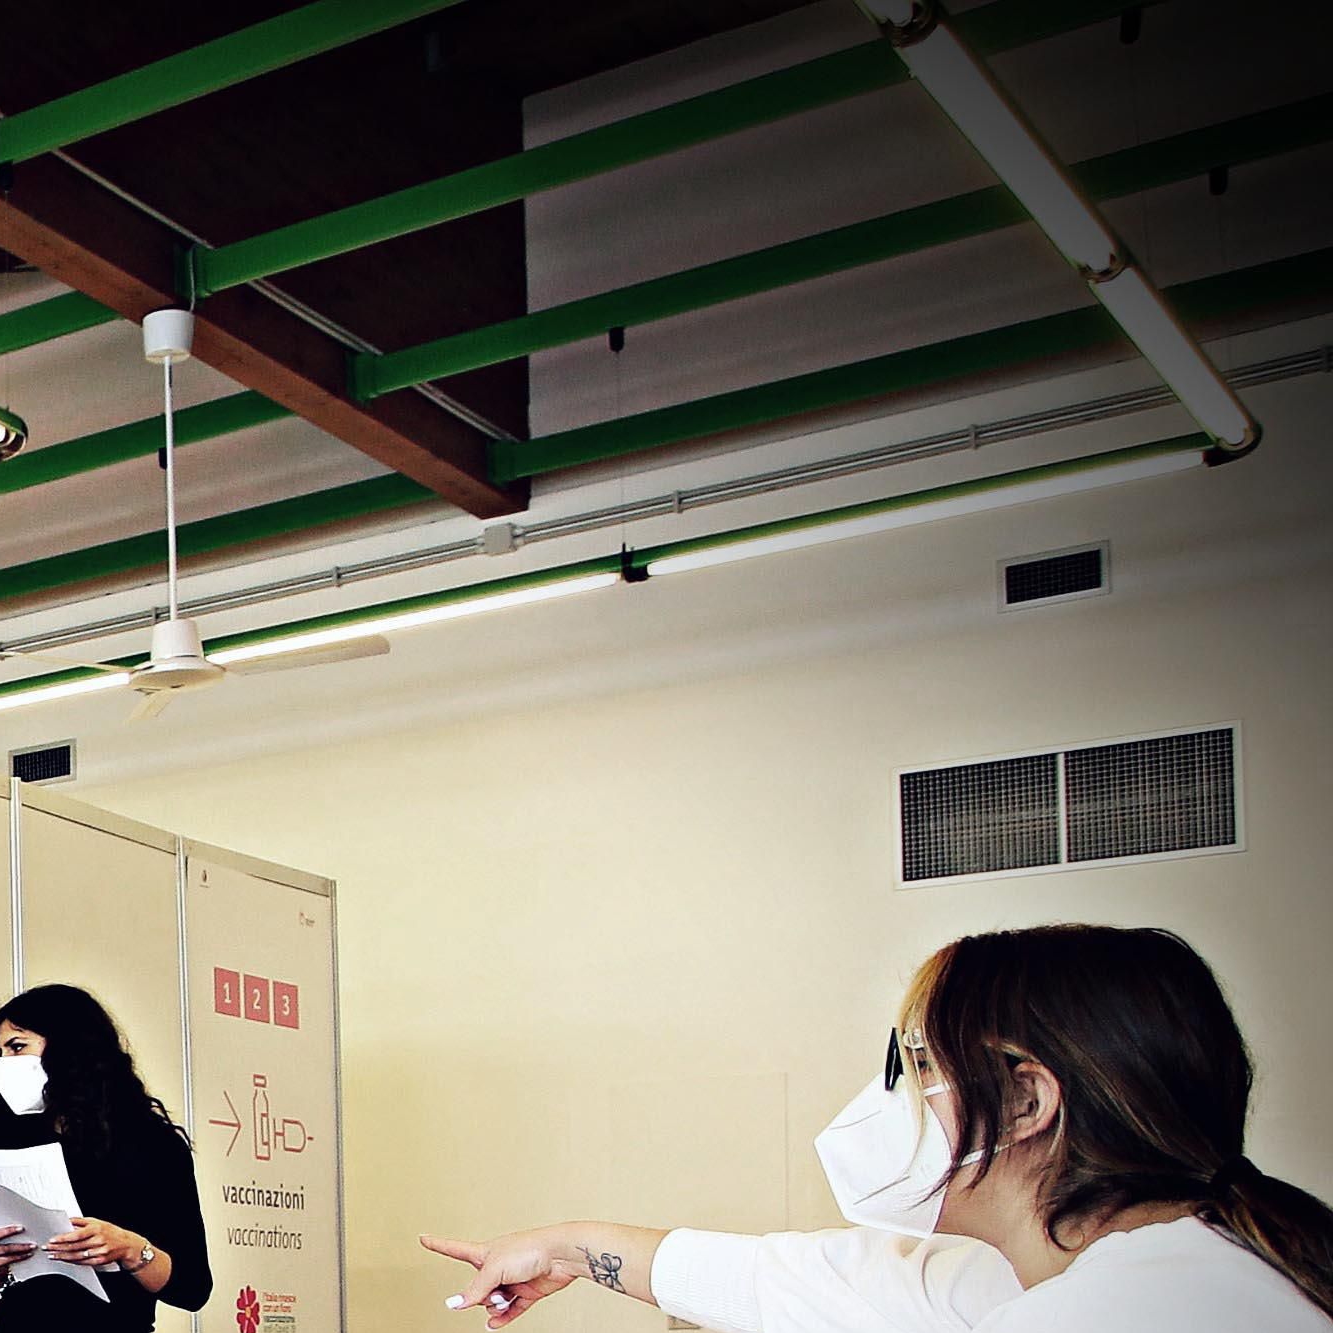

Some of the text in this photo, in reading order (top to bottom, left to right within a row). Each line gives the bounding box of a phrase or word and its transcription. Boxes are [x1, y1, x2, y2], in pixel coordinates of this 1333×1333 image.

[223, 982, 290, 1016] 1 2 3
[222, 1180, 305, 1210] vaccinazioni
[228, 1222, 303, 1250] vaccinations
